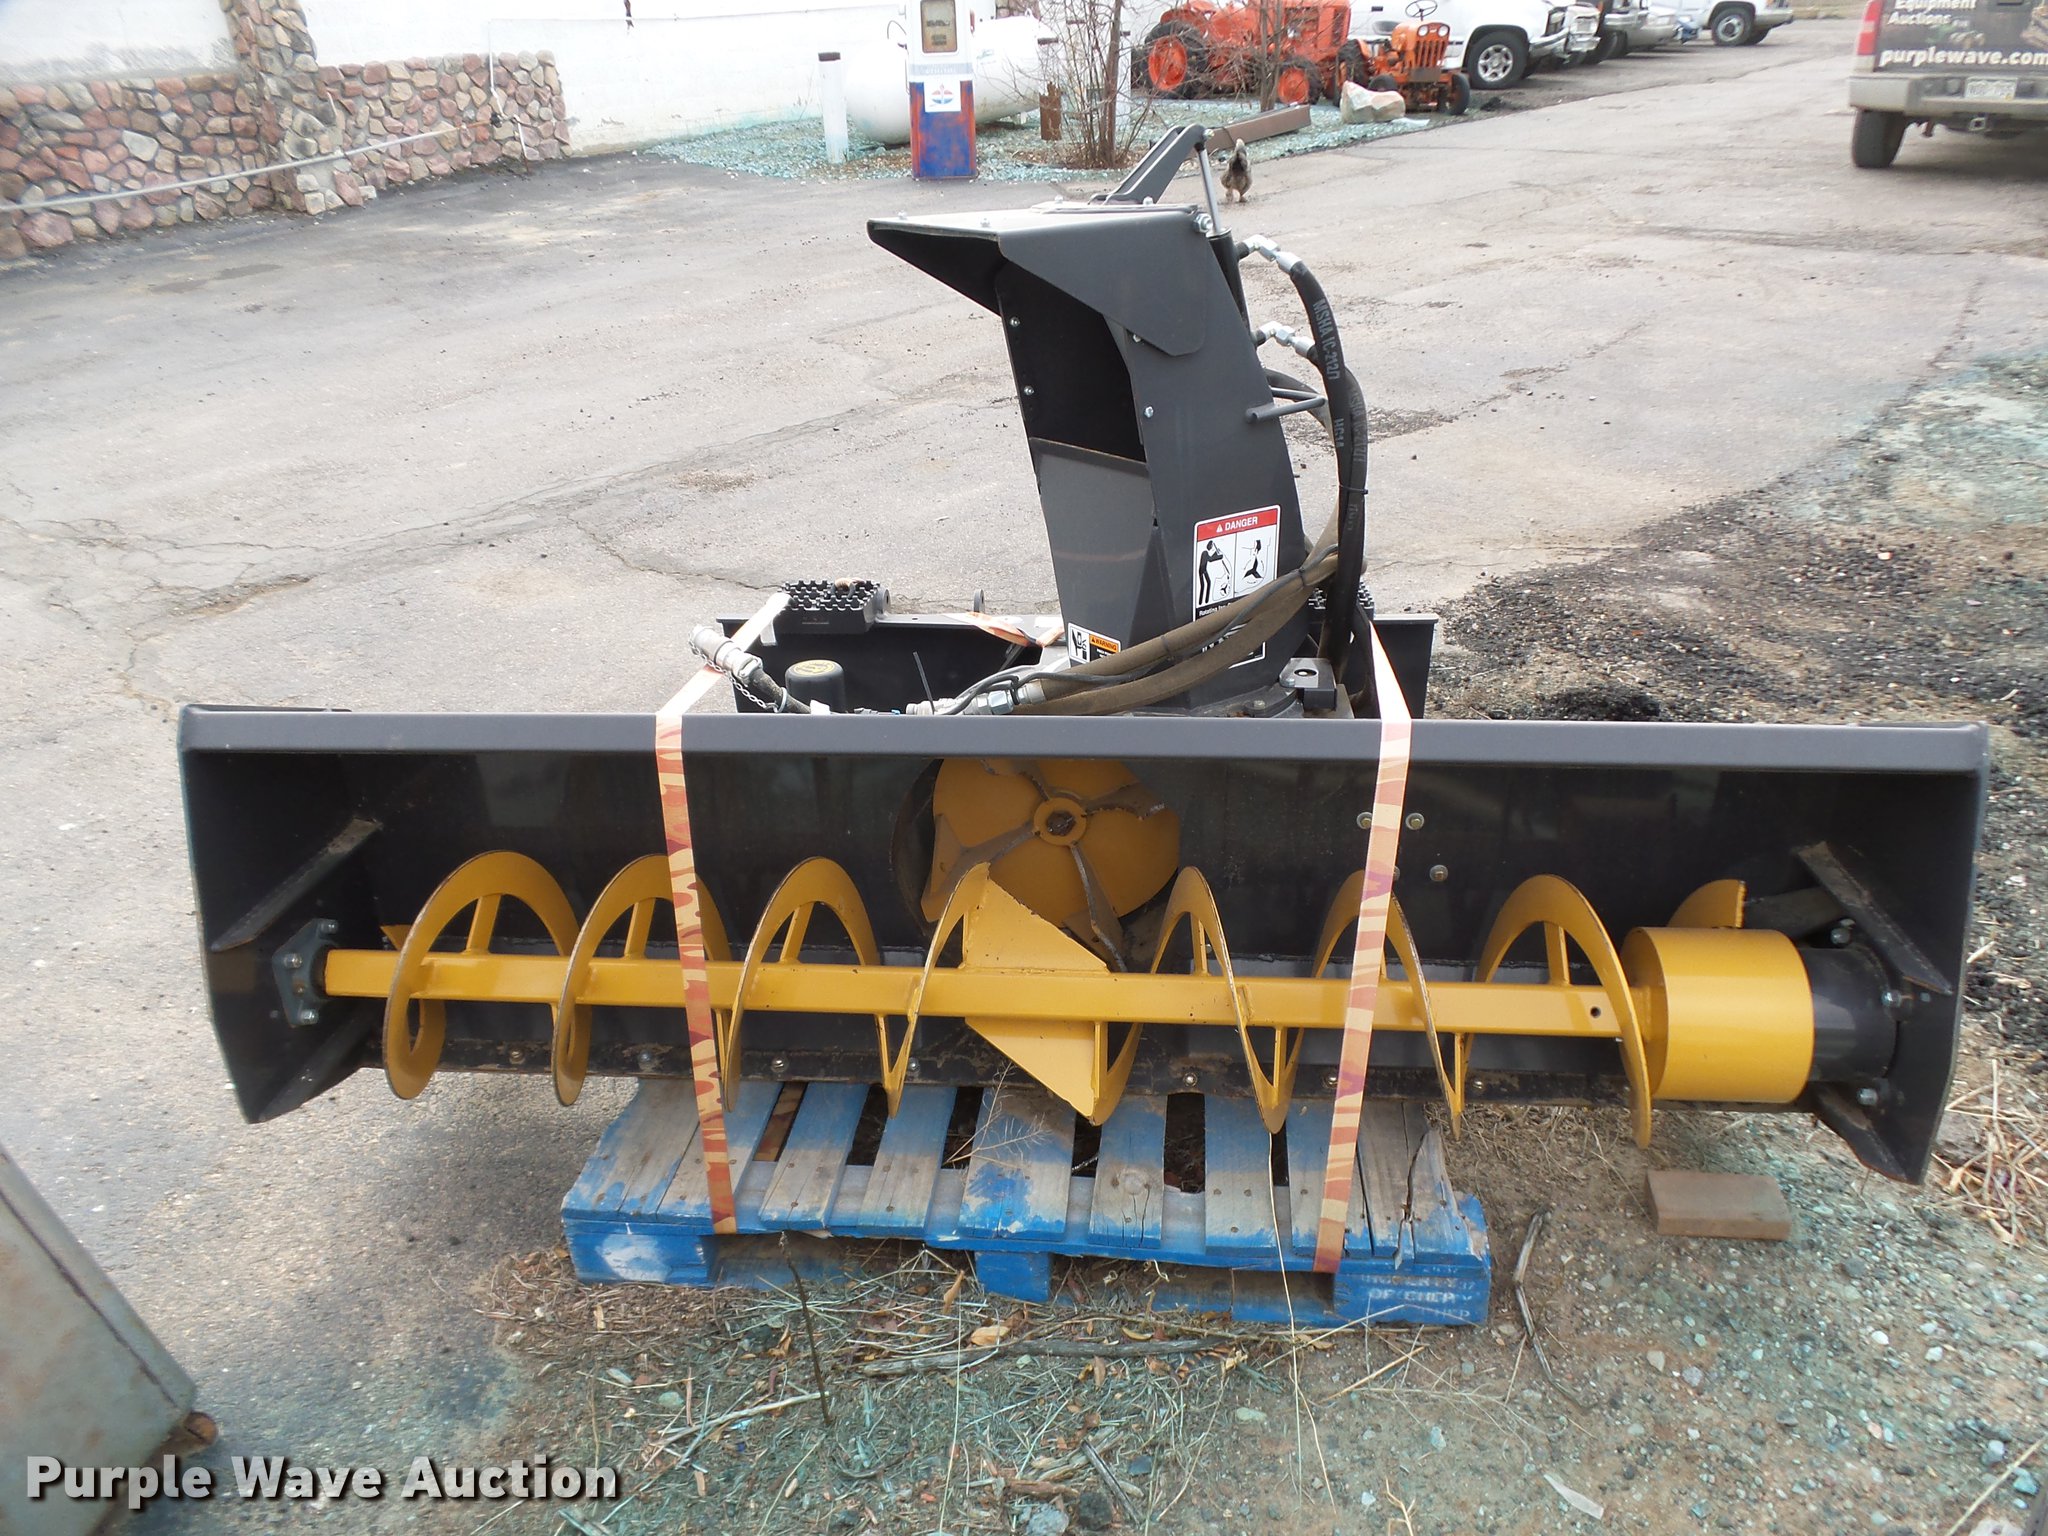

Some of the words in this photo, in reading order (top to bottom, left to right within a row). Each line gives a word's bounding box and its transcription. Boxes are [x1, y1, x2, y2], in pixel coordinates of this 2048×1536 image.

[1888, 11, 1951, 25] Auctions
[1879, 45, 2048, 67] purplewave.com
[1312, 298, 1334, 338] MSHA
[1225, 516, 1258, 531] DANGER
[1095, 638, 1117, 651] WARNING
